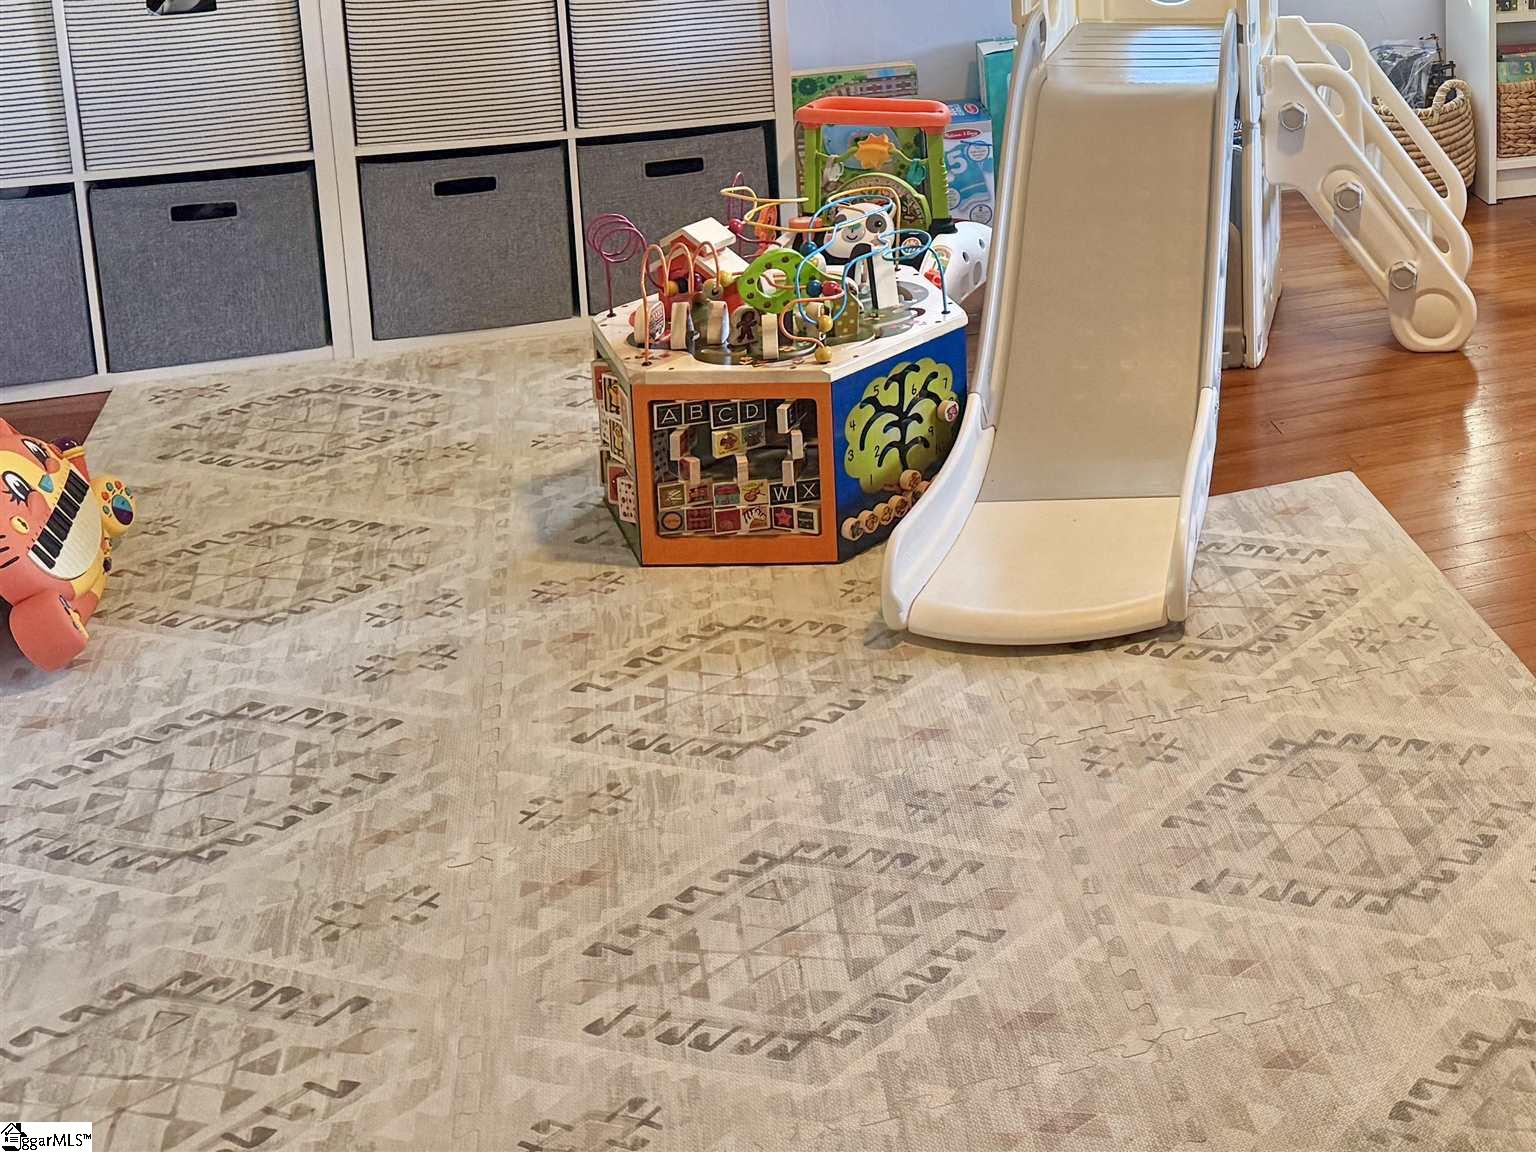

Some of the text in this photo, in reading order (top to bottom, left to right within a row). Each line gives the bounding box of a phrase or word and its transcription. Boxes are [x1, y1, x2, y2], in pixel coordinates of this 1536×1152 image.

[1523, 61, 1534, 74] 3
[911, 383, 917, 396] 6
[942, 377, 948, 389] 7
[873, 384, 880, 396] 5
[661, 408, 678, 425] A
[690, 404, 703, 420] B
[718, 407, 737, 422] C
[746, 404, 759, 419] D
[849, 419, 856, 431] 4
[927, 425, 934, 436] 9
[847, 449, 854, 461] 3
[874, 445, 880, 458] 2
[774, 486, 789, 502] W
[802, 483, 815, 498] X
